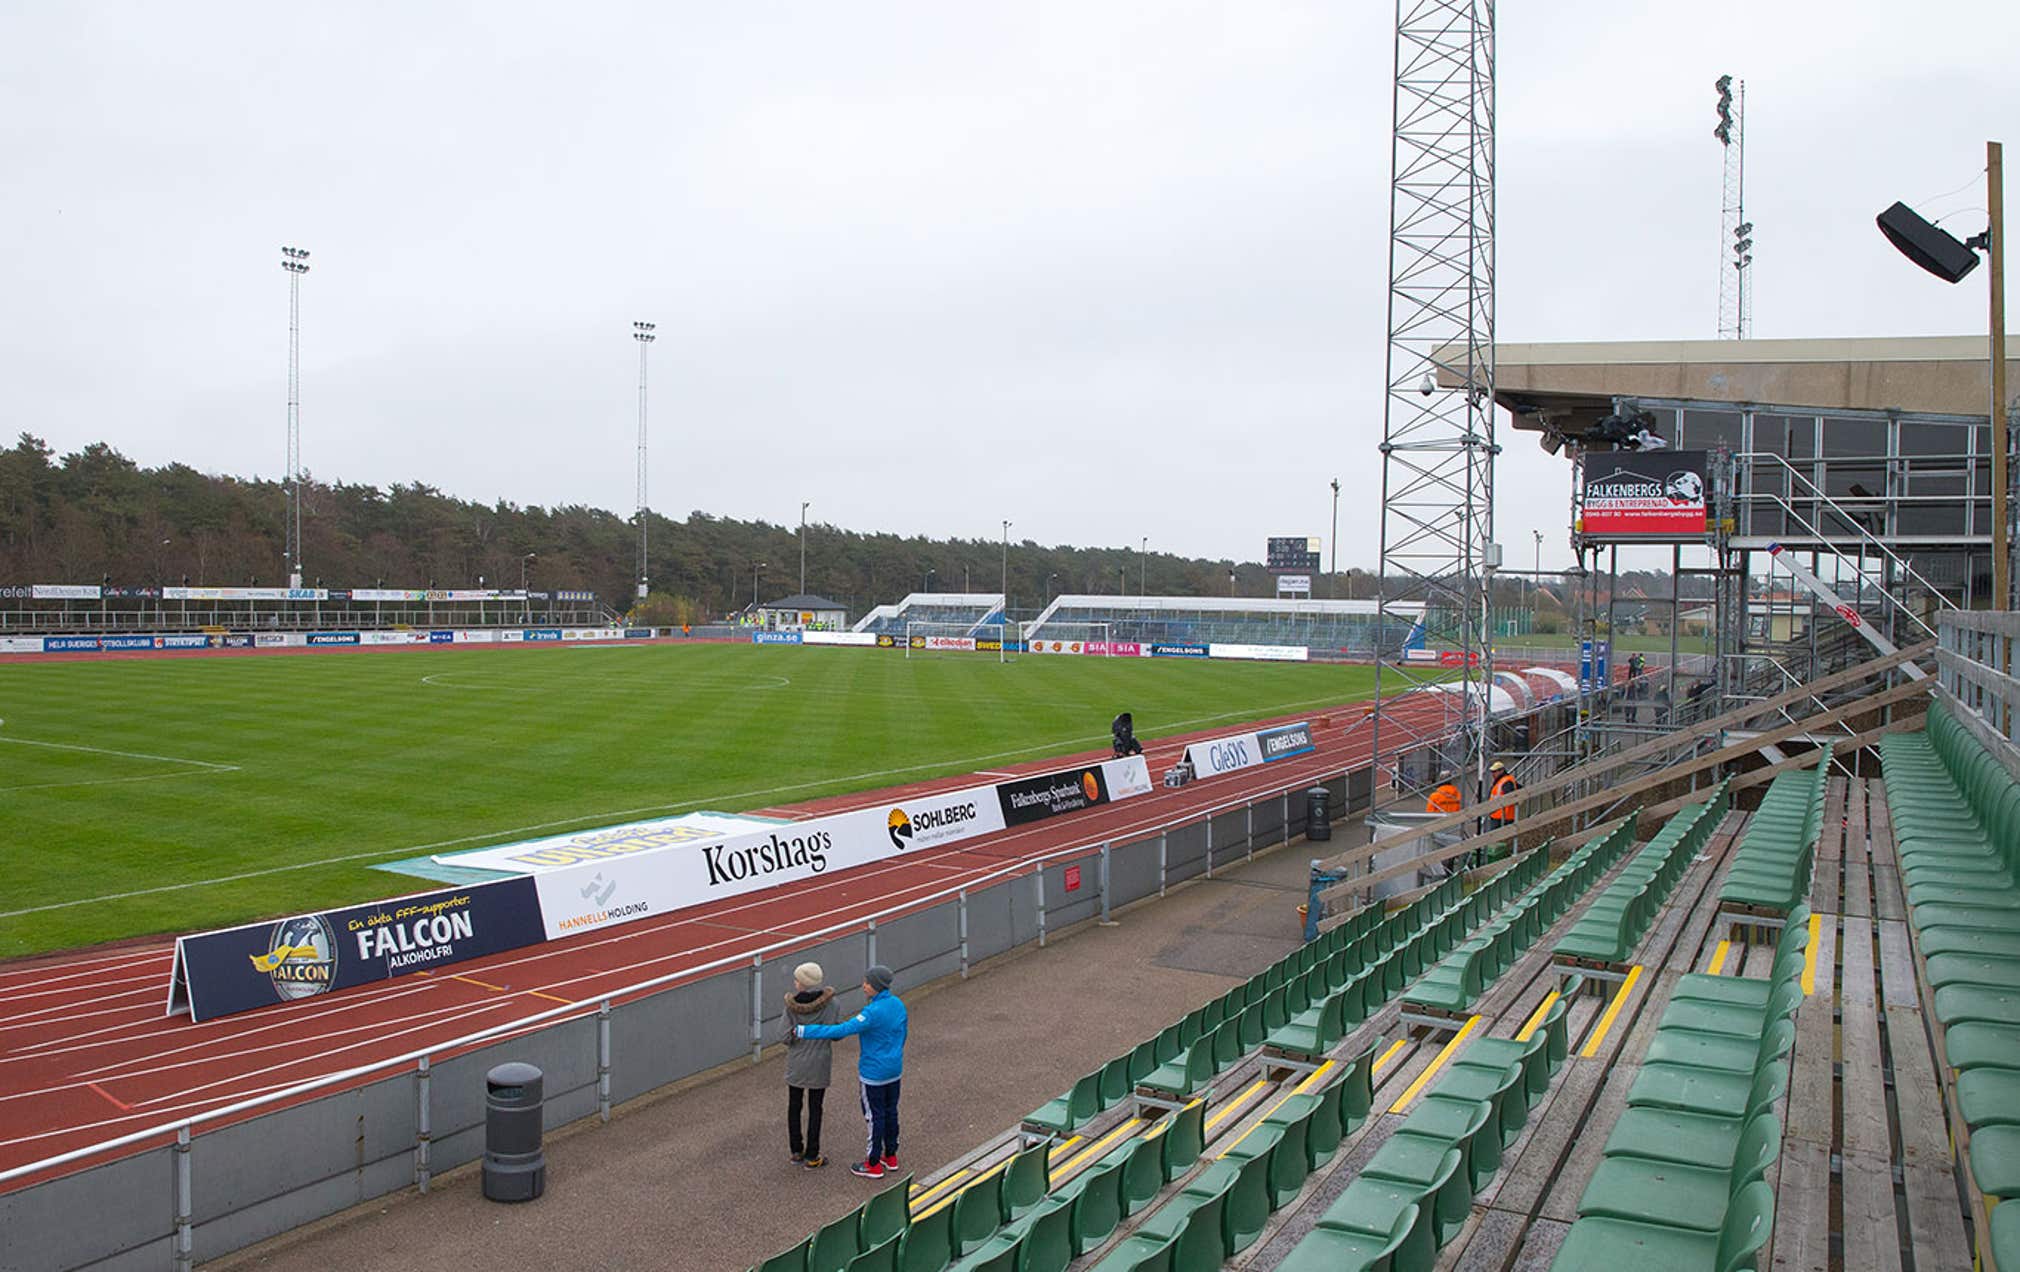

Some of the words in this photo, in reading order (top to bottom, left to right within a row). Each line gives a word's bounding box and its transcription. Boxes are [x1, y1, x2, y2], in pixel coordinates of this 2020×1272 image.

[1586, 483, 1662, 497] FALKENBERGS
[288, 589, 316, 599] SKAB
[756, 632, 798, 643] ginza.se
[1118, 644, 1136, 652] SIA
[1010, 789, 1051, 809] Falkenbergs
[1050, 782, 1081, 802] Sparbank
[913, 803, 976, 832] SOHLBERG
[348, 919, 364, 931] En
[368, 913, 393, 927] äkta
[356, 910, 474, 961] FALCON
[390, 944, 453, 969] ALKOHOLFRI
